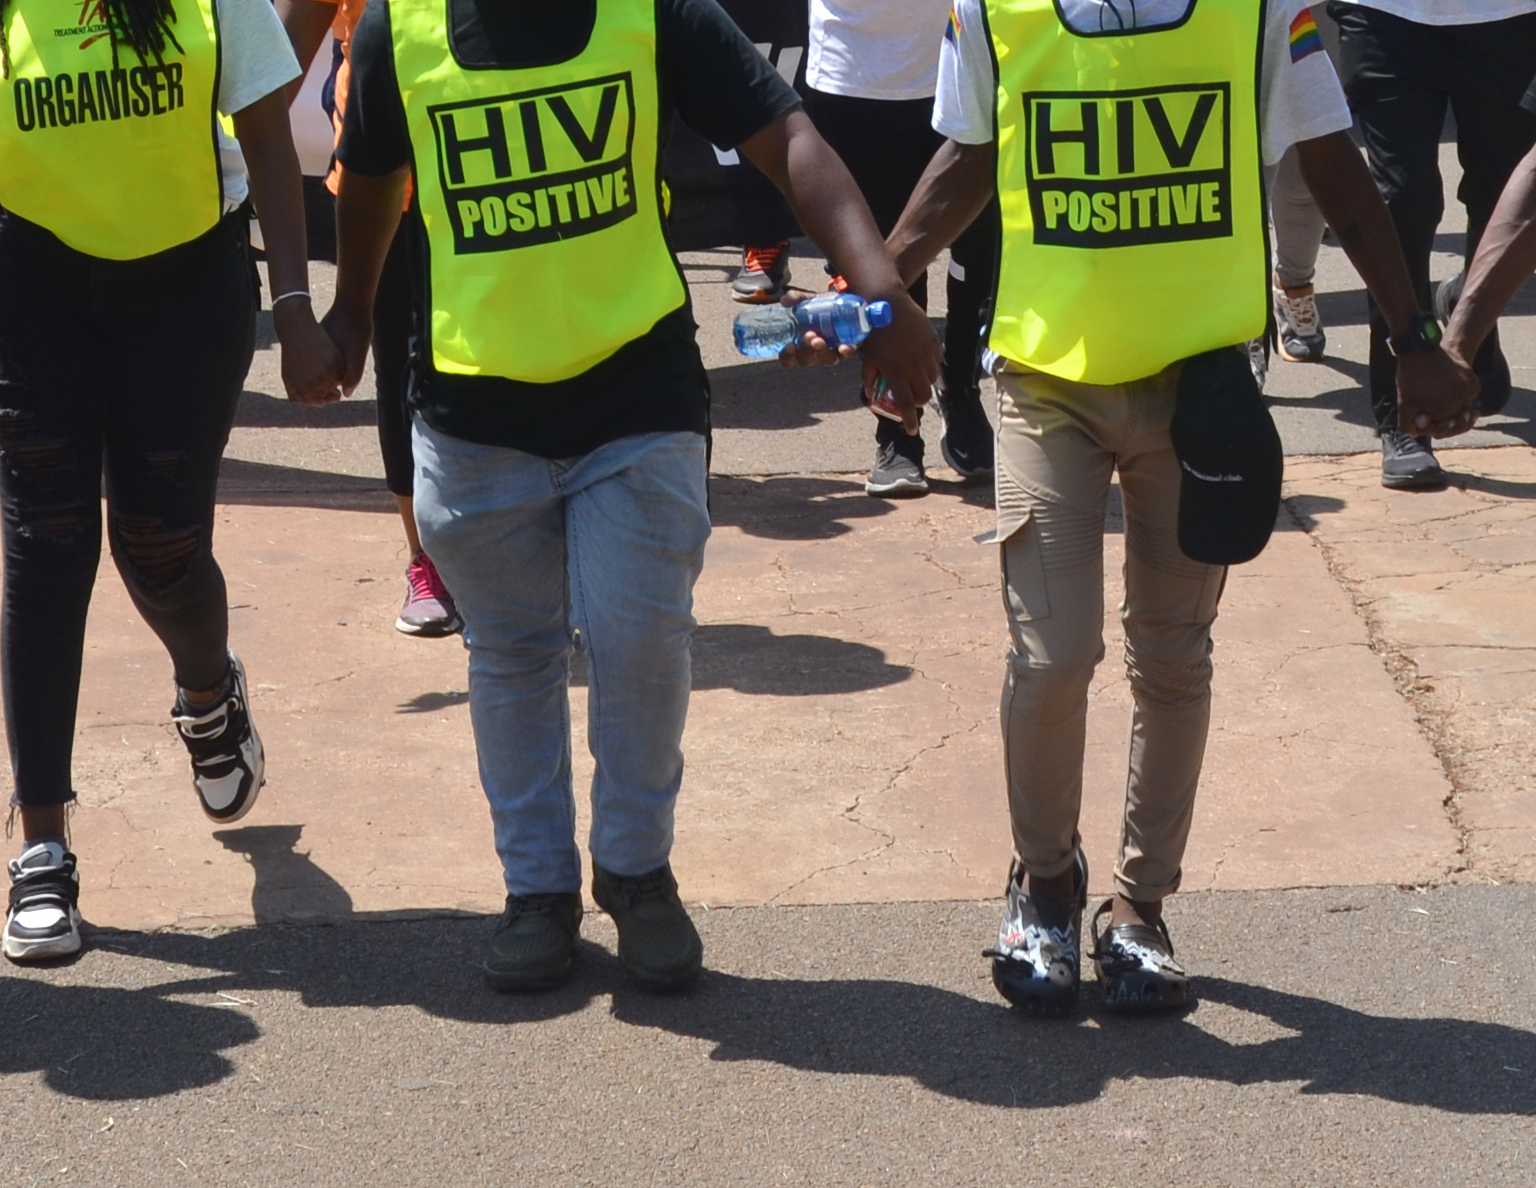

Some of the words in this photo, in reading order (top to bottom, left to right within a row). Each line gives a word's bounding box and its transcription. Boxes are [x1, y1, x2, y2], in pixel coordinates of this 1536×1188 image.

[13, 62, 184, 132] ORGANISER
[441, 84, 621, 185] HIV
[1035, 93, 1219, 176] HIV
[456, 166, 630, 241] POSITIVE
[1041, 181, 1222, 233] POSITIVE
